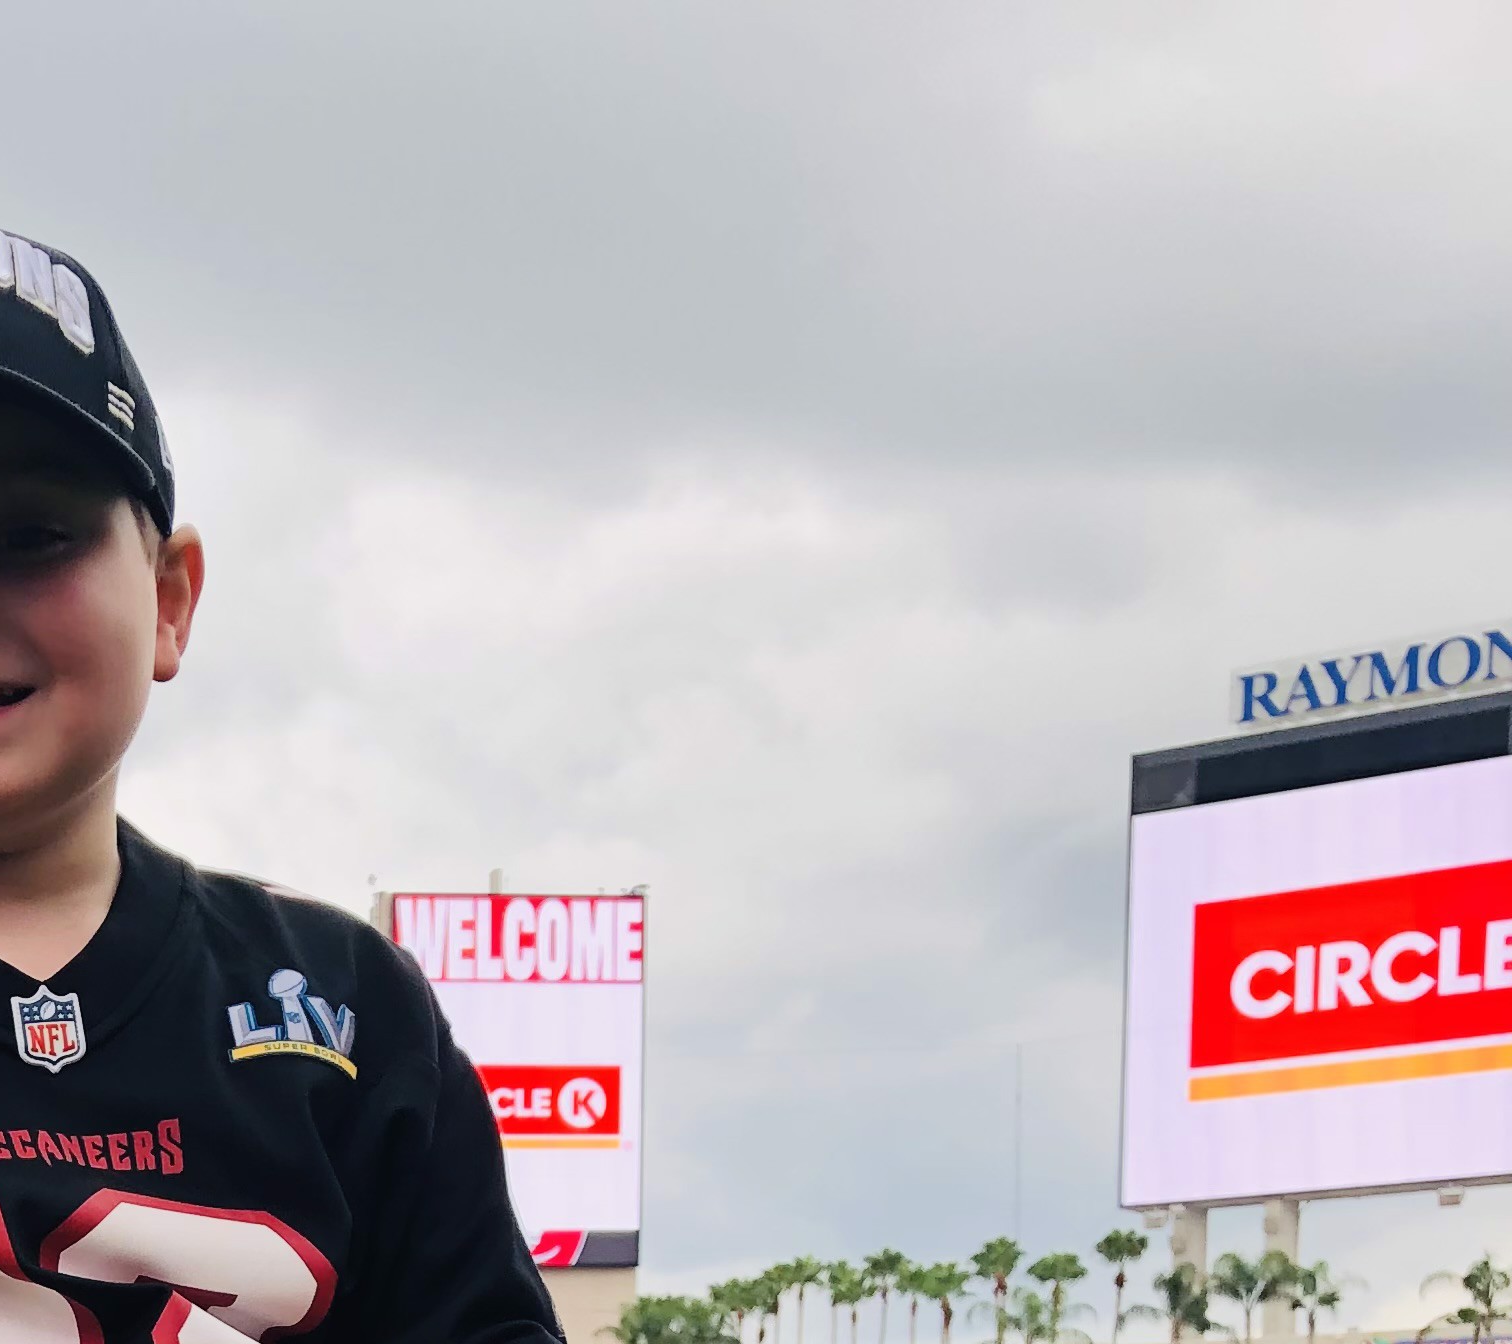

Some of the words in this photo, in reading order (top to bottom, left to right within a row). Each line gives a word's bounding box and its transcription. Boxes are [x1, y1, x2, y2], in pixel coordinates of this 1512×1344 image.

[398, 897, 642, 981] WELCOME
[1230, 918, 1512, 1019] CIRCLE
[26, 1021, 76, 1057] NFL
[264, 1043, 308, 1052] SUPER
[488, 1086, 553, 1119] CLE
